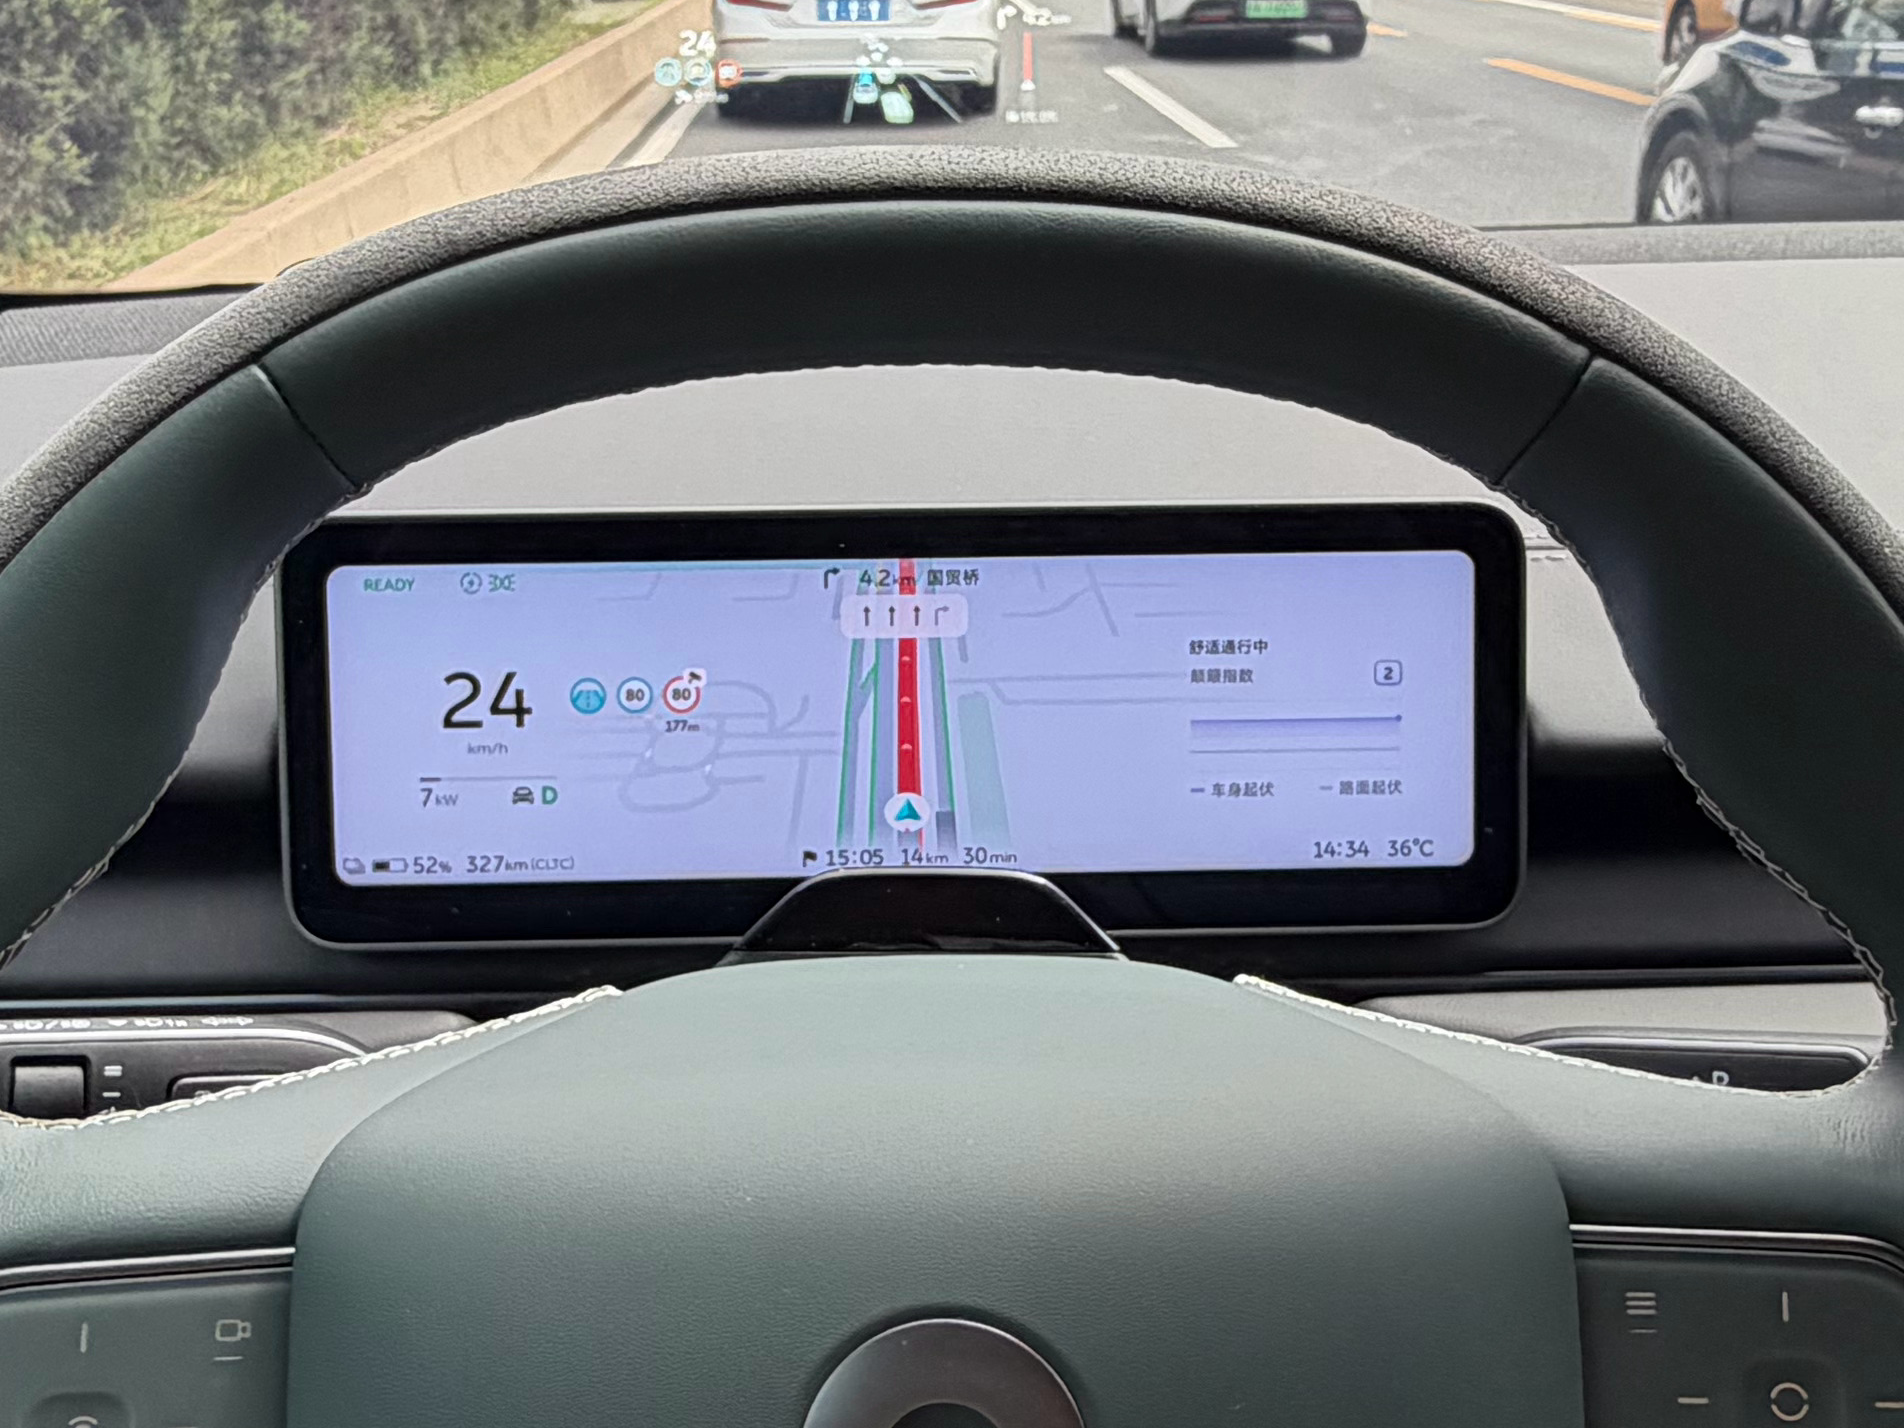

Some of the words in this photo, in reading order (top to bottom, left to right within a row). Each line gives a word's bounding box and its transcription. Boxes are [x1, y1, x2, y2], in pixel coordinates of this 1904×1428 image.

[363, 576, 416, 593] READY
[927, 568, 980, 587] 国贸桥
[1189, 638, 1269, 656] 舒适通行中
[1383, 666, 1394, 681] 2
[442, 671, 533, 729] 24
[624, 687, 645, 704] 80
[671, 687, 692, 704] 80
[467, 741, 509, 756] km/h
[541, 785, 559, 806] D
[1211, 781, 1275, 798] 车身起伏
[1339, 779, 1403, 796] 路面起伏
[1313, 840, 1370, 859] 14:34
[1387, 837, 1435, 859] 36°C
[413, 855, 453, 874] 52%
[826, 848, 884, 866] 15:05
